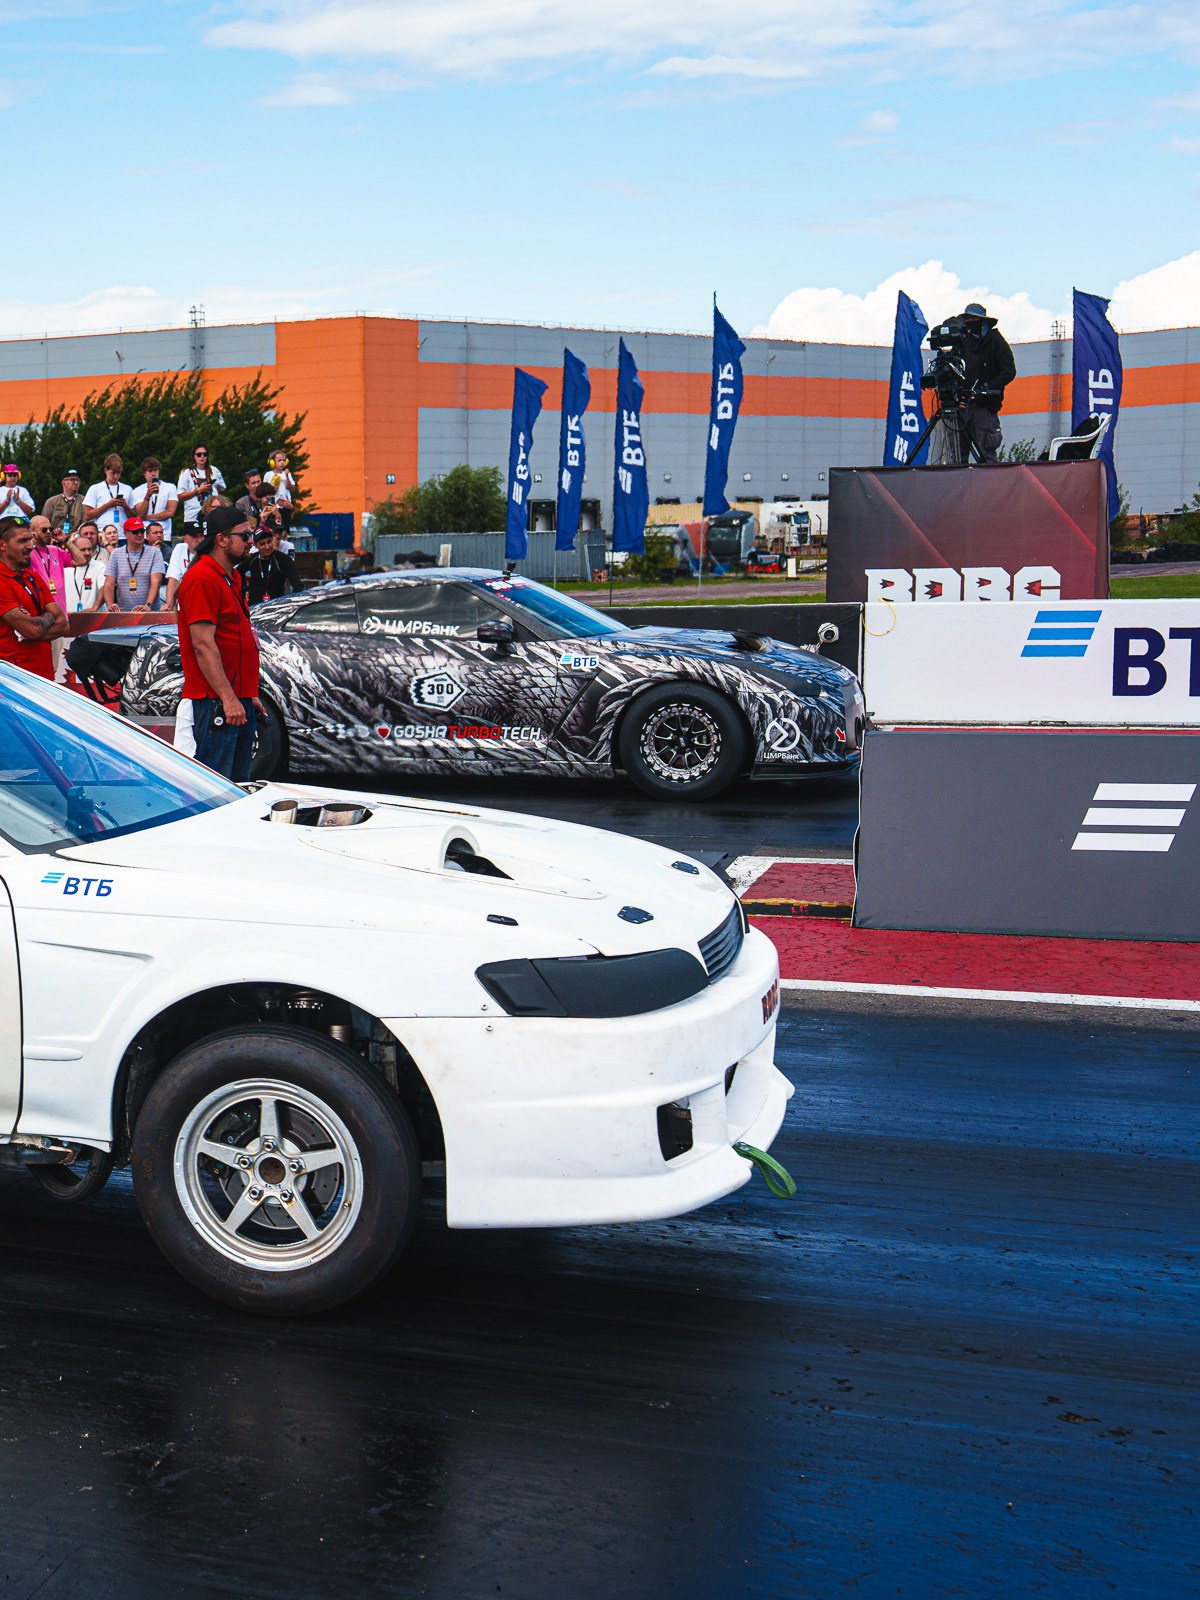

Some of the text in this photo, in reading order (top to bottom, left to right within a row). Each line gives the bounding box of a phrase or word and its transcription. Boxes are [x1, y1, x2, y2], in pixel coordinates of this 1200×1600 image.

[864, 566, 1062, 601] RDRC
[384, 619, 461, 637] ЦМРБанк
[573, 657, 597, 667] ВТБ
[427, 683, 454, 695] 300
[763, 752, 800, 760] ЦМРБанк
[63, 877, 114, 897] ВТБ
